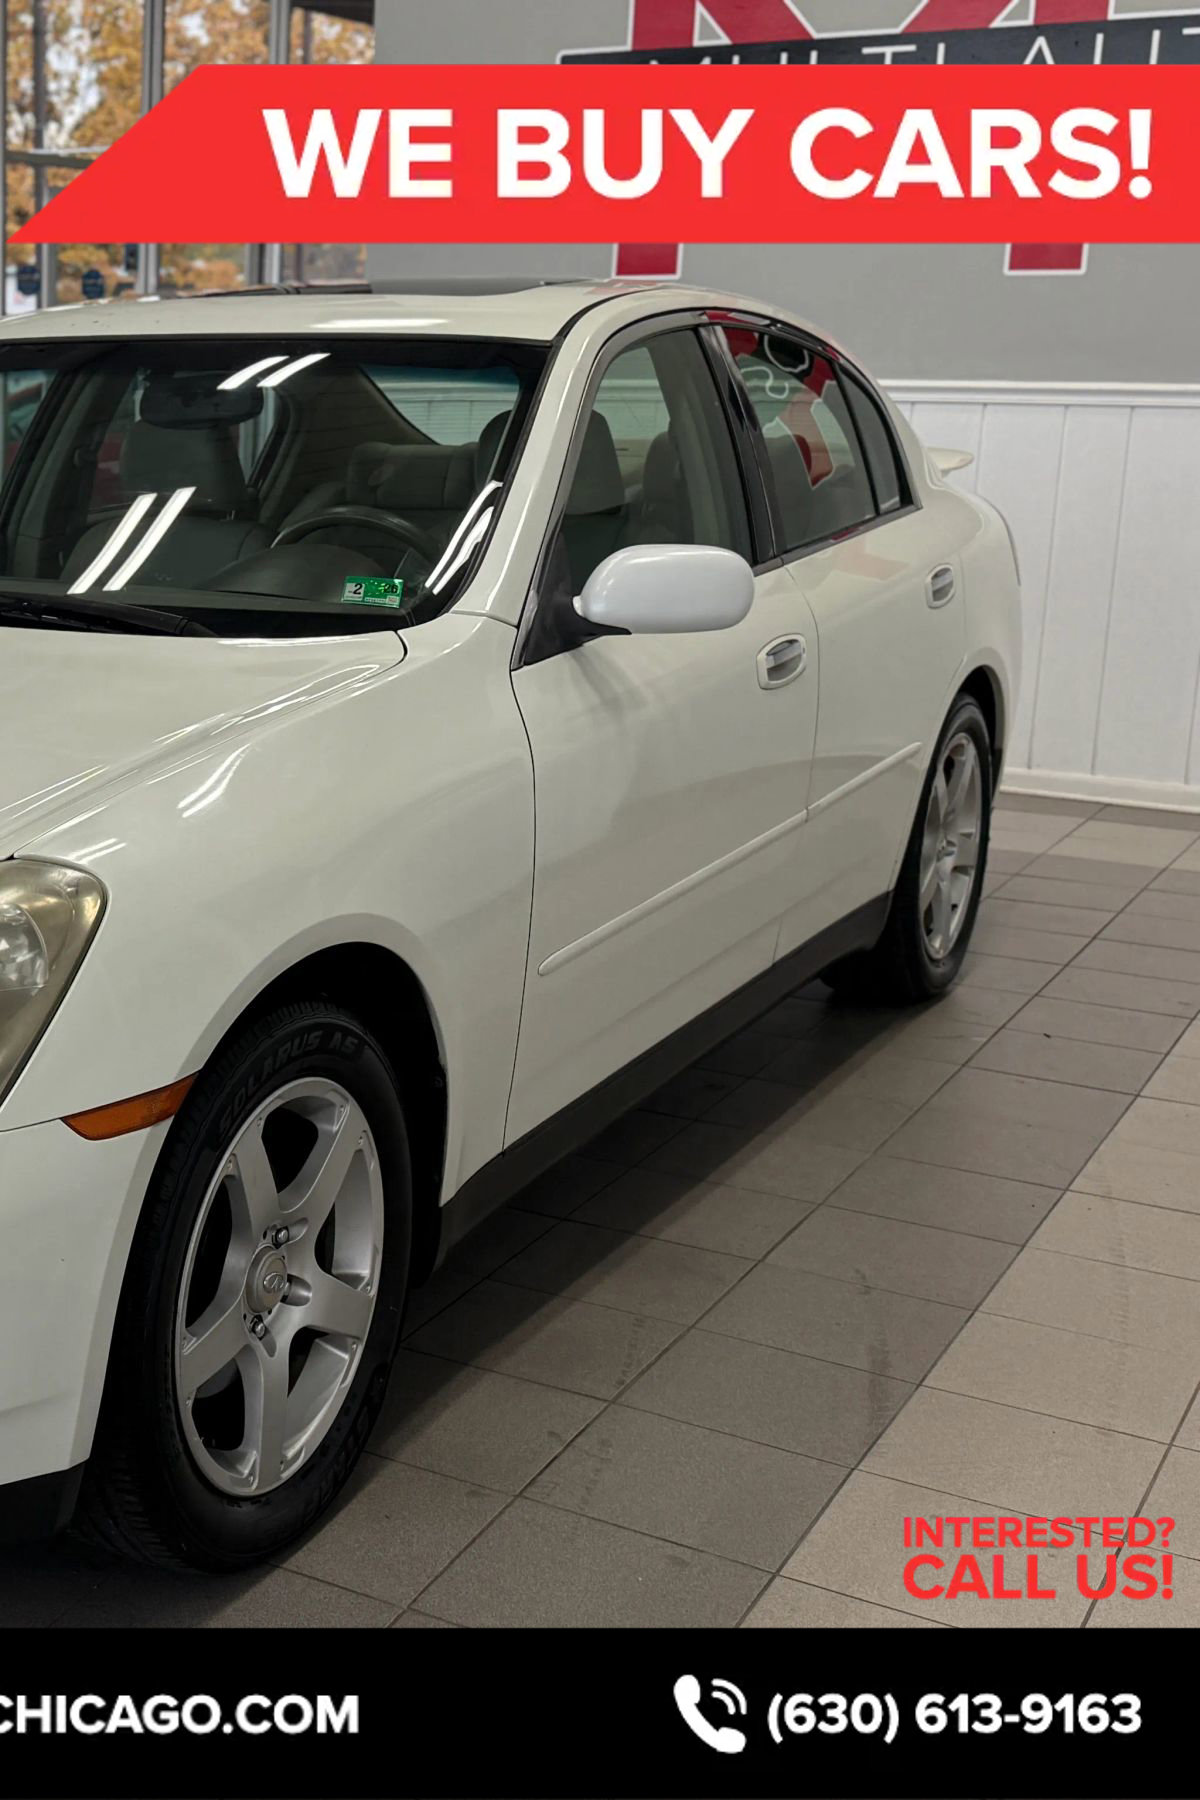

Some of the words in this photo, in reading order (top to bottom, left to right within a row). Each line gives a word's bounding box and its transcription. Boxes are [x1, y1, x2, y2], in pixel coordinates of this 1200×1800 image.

[353, 583, 363, 595] 2
[384, 584, 399, 594] 26
[218, 1030, 323, 1133] SOLARUS
[328, 1031, 359, 1056] AS
